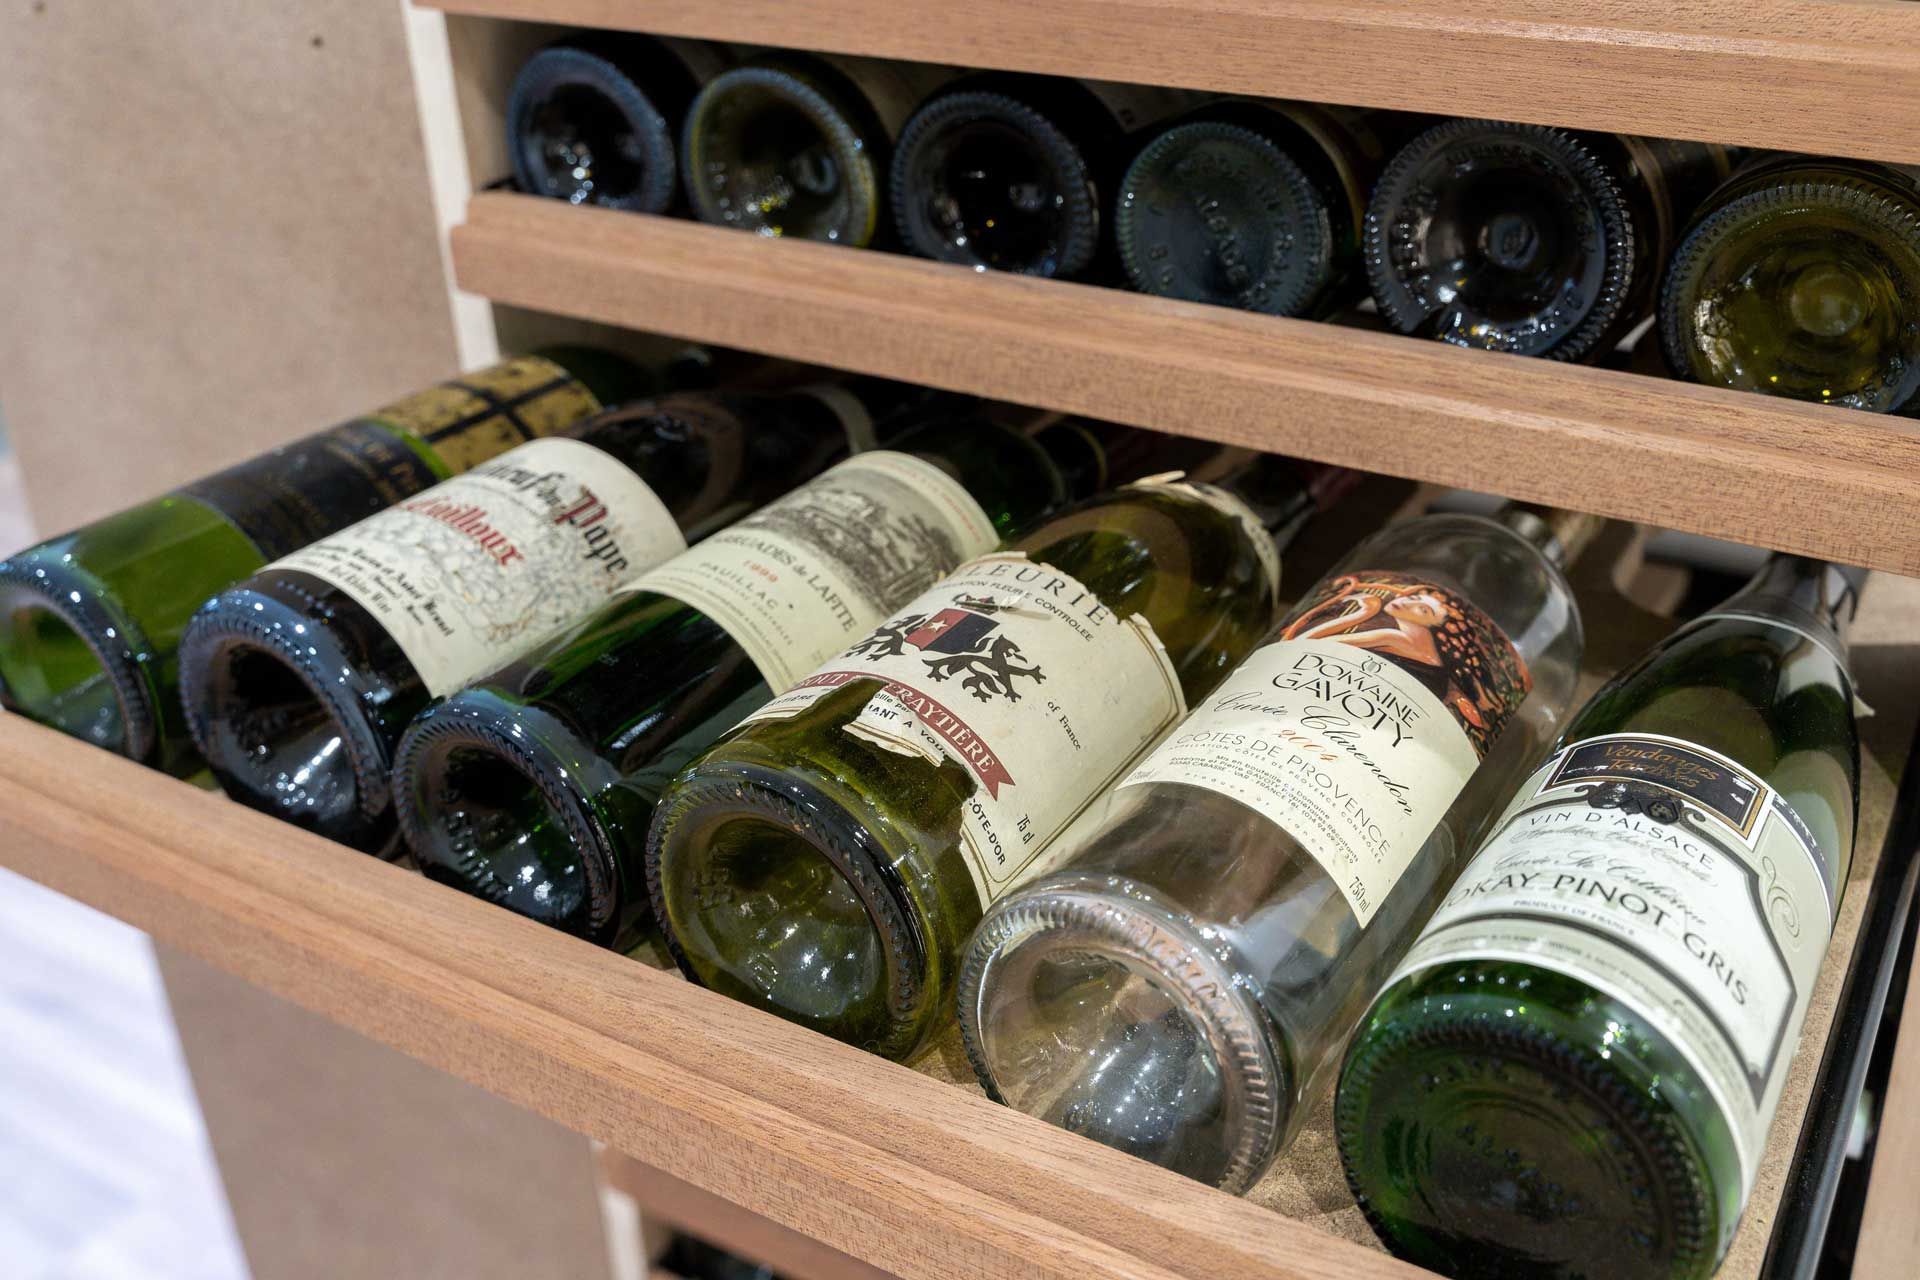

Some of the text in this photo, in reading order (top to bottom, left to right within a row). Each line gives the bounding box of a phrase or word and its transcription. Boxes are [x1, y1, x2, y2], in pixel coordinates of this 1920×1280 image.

[700, 560, 779, 610] PAUILLAC
[806, 573, 858, 633] LAFITE
[964, 563, 1111, 627] LEURIE
[1271, 671, 1415, 749] GAVOTY
[1292, 653, 1421, 729] DOMAINE
[902, 719, 914, 730] A
[918, 729, 949, 755] VOU
[1046, 700, 1082, 752] of France
[1213, 690, 1419, 818] Cuvée Clarendon
[1245, 768, 1282, 790] GAVOTY
[1604, 744, 1719, 782] Vendanges
[1606, 759, 1700, 789] Tardives
[1233, 770, 1250, 781] VAR
[1254, 780, 1290, 801] FRANCE
[1243, 761, 1283, 784] bouteille
[1296, 789, 1331, 821] Domaine
[1249, 739, 1284, 759] DE
[1286, 753, 1392, 857] PROVENCE
[1287, 769, 1338, 809] PROVENCE
[1016, 813, 1036, 845] 75 cl
[1530, 811, 1715, 871] VIN D'ALSACE
[1349, 875, 1371, 913] 750 ml
[1553, 873, 1671, 927] PINOT
[1683, 931, 1749, 1006] GRIS
